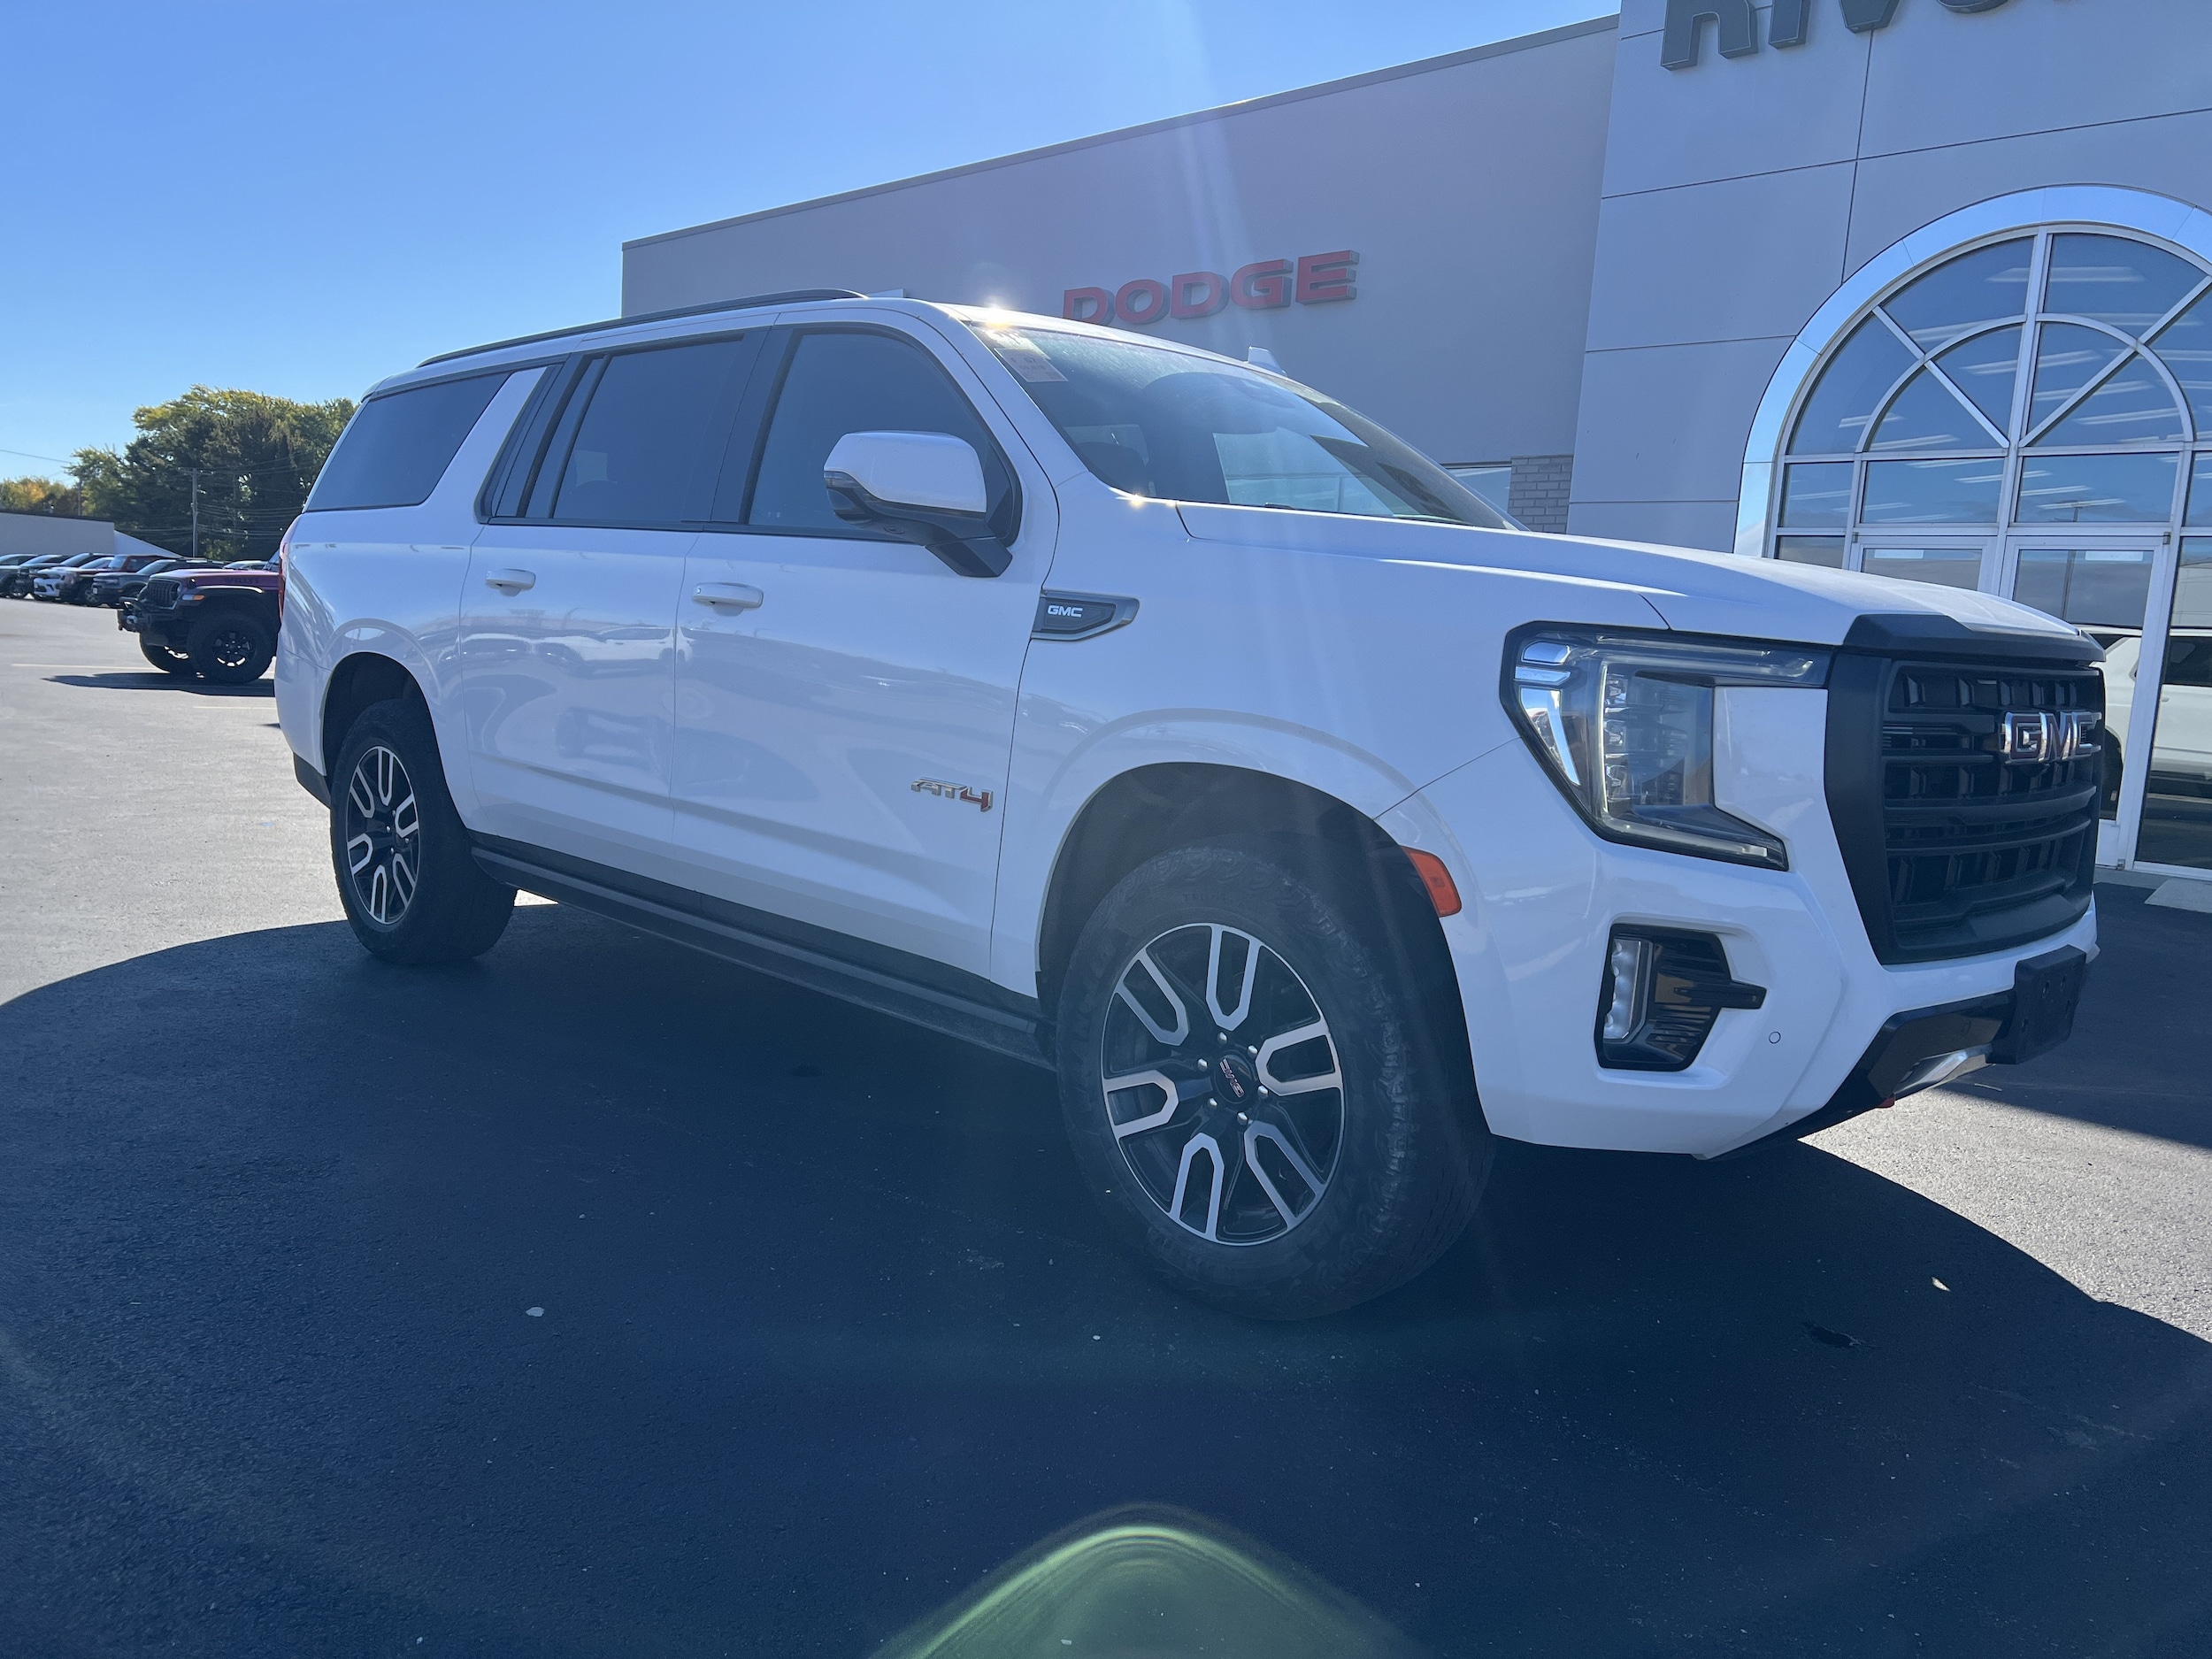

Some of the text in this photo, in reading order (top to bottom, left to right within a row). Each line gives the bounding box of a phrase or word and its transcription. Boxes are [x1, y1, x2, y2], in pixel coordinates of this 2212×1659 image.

[1063, 250, 1359, 326] DODGE
[1047, 605, 1083, 618] GMC
[2001, 711, 2102, 764] GMC
[910, 777, 994, 812] AT4
[1219, 1057, 1245, 1098] GMC
